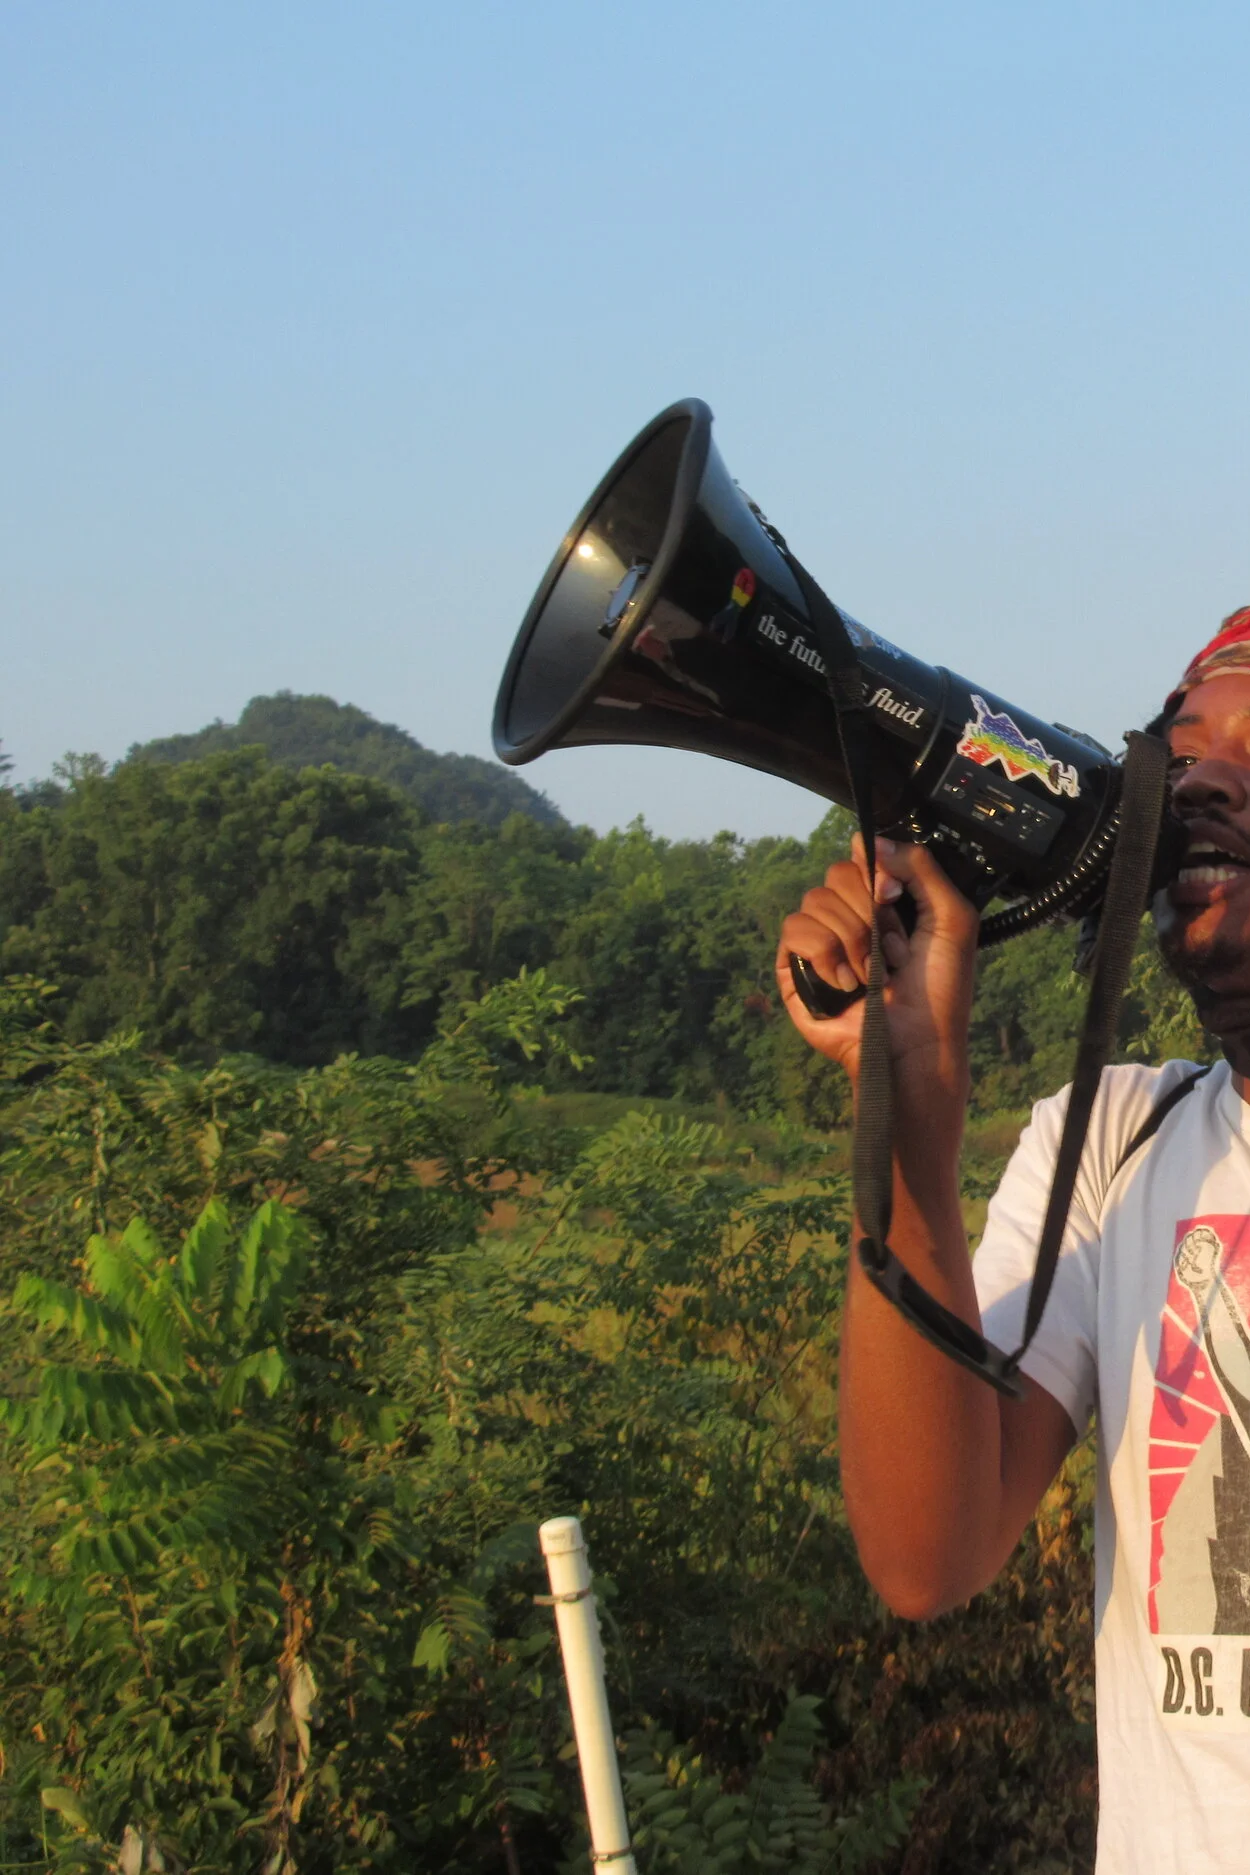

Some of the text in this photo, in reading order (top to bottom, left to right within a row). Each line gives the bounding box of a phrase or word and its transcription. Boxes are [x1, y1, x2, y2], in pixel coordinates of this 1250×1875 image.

[757, 614, 788, 646] the
[864, 687, 924, 729] fluid.
[1161, 1646, 1224, 1716] D.C.
